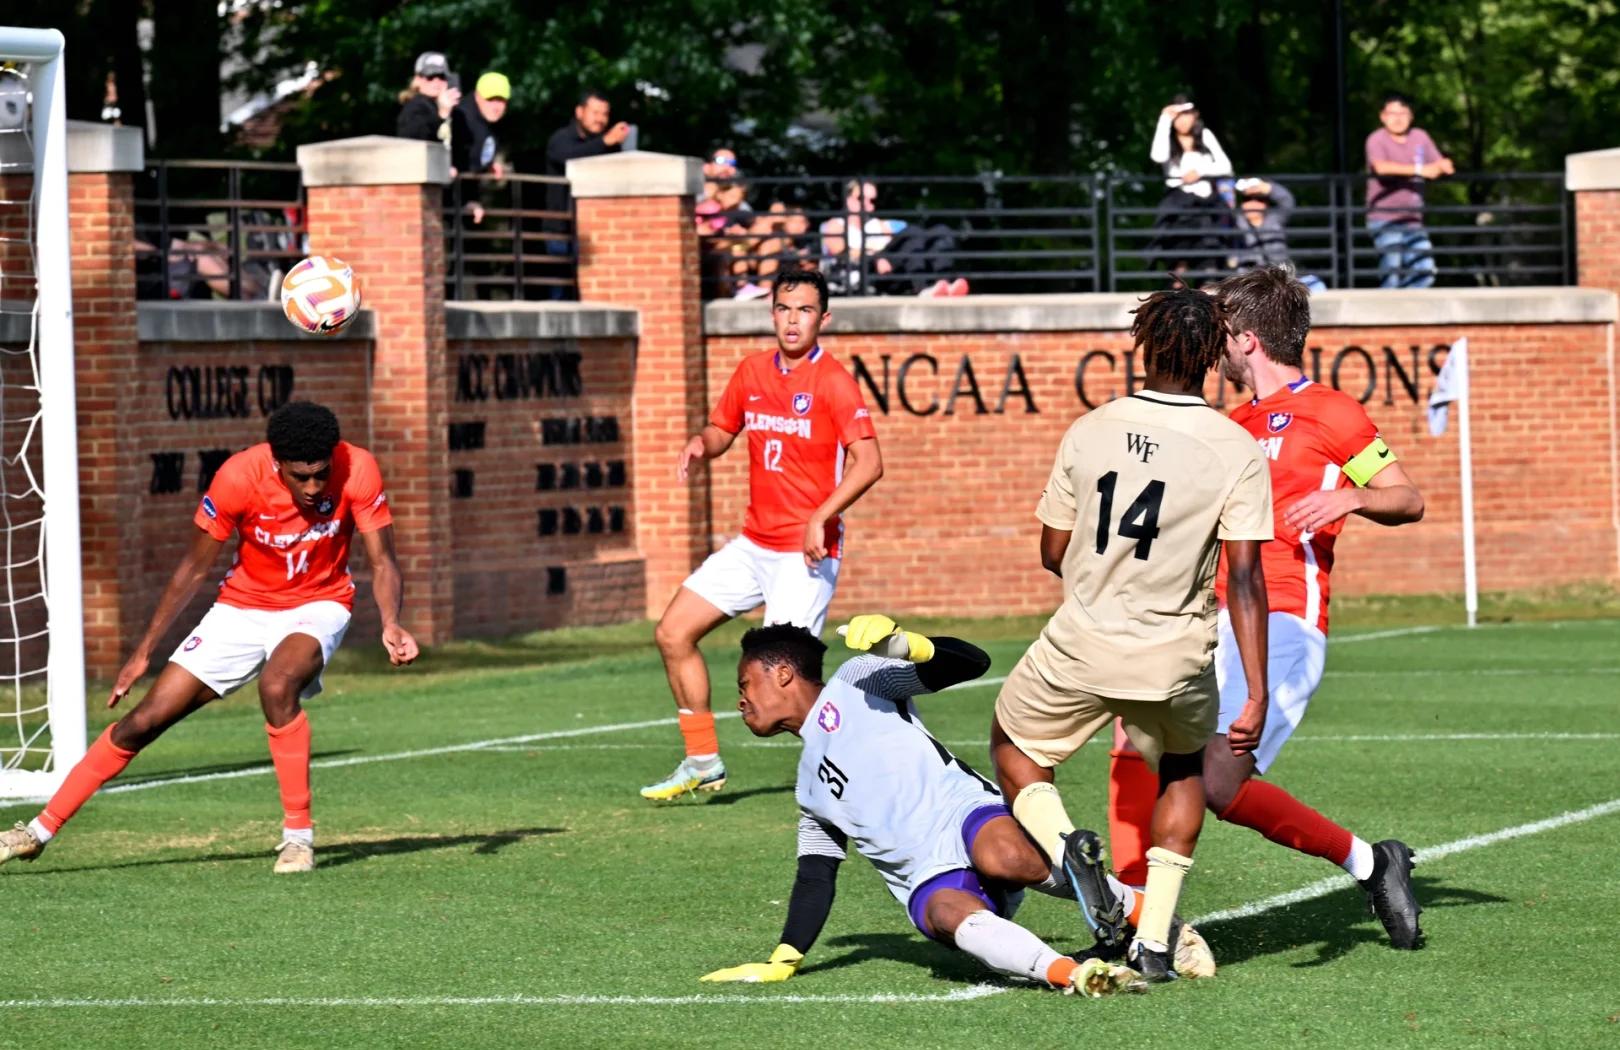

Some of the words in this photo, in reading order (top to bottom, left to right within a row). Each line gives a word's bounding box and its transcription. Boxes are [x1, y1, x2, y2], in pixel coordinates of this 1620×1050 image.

[851, 353, 1040, 416] NCAA
[1075, 344, 1453, 411] CHION
[744, 411, 811, 440] CLEMSON
[763, 438, 784, 473] 12
[1126, 432, 1159, 464] WF
[1095, 470, 1166, 561] 14
[286, 549, 309, 581] 14
[818, 754, 849, 800] 31
